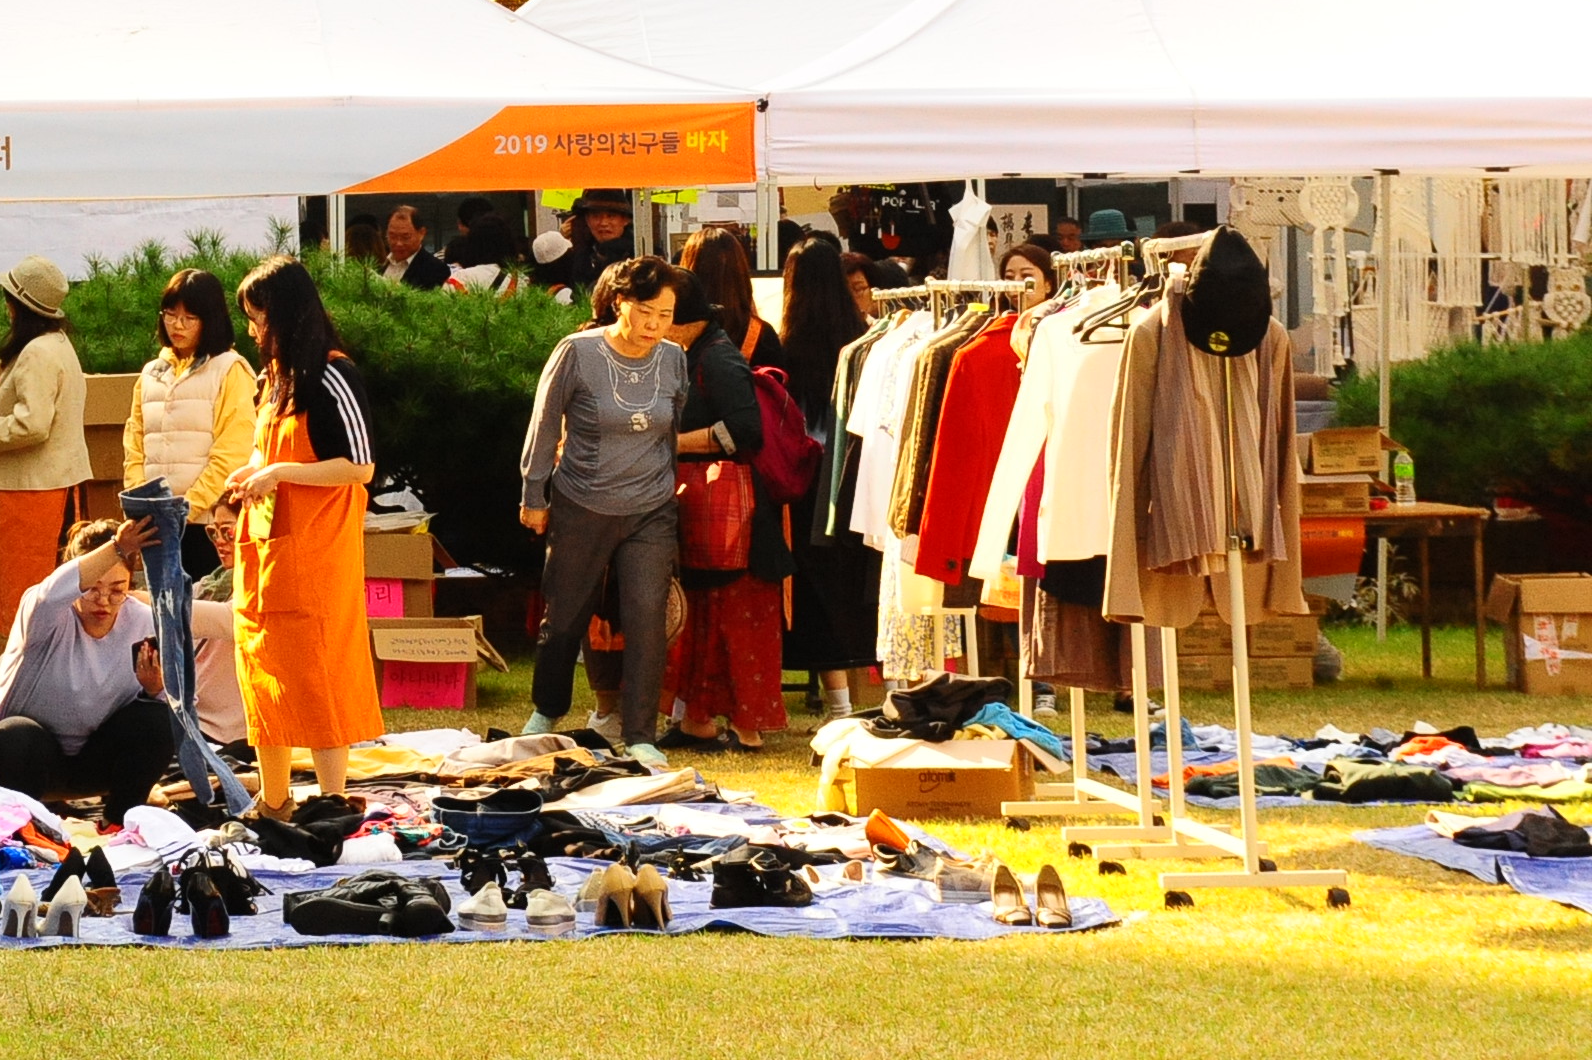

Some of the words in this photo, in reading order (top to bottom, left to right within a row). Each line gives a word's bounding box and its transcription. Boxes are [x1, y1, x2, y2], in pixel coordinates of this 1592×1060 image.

[494, 134, 548, 155] 2019
[554, 131, 681, 158] 사랑의친구들
[686, 129, 729, 153] 바자
